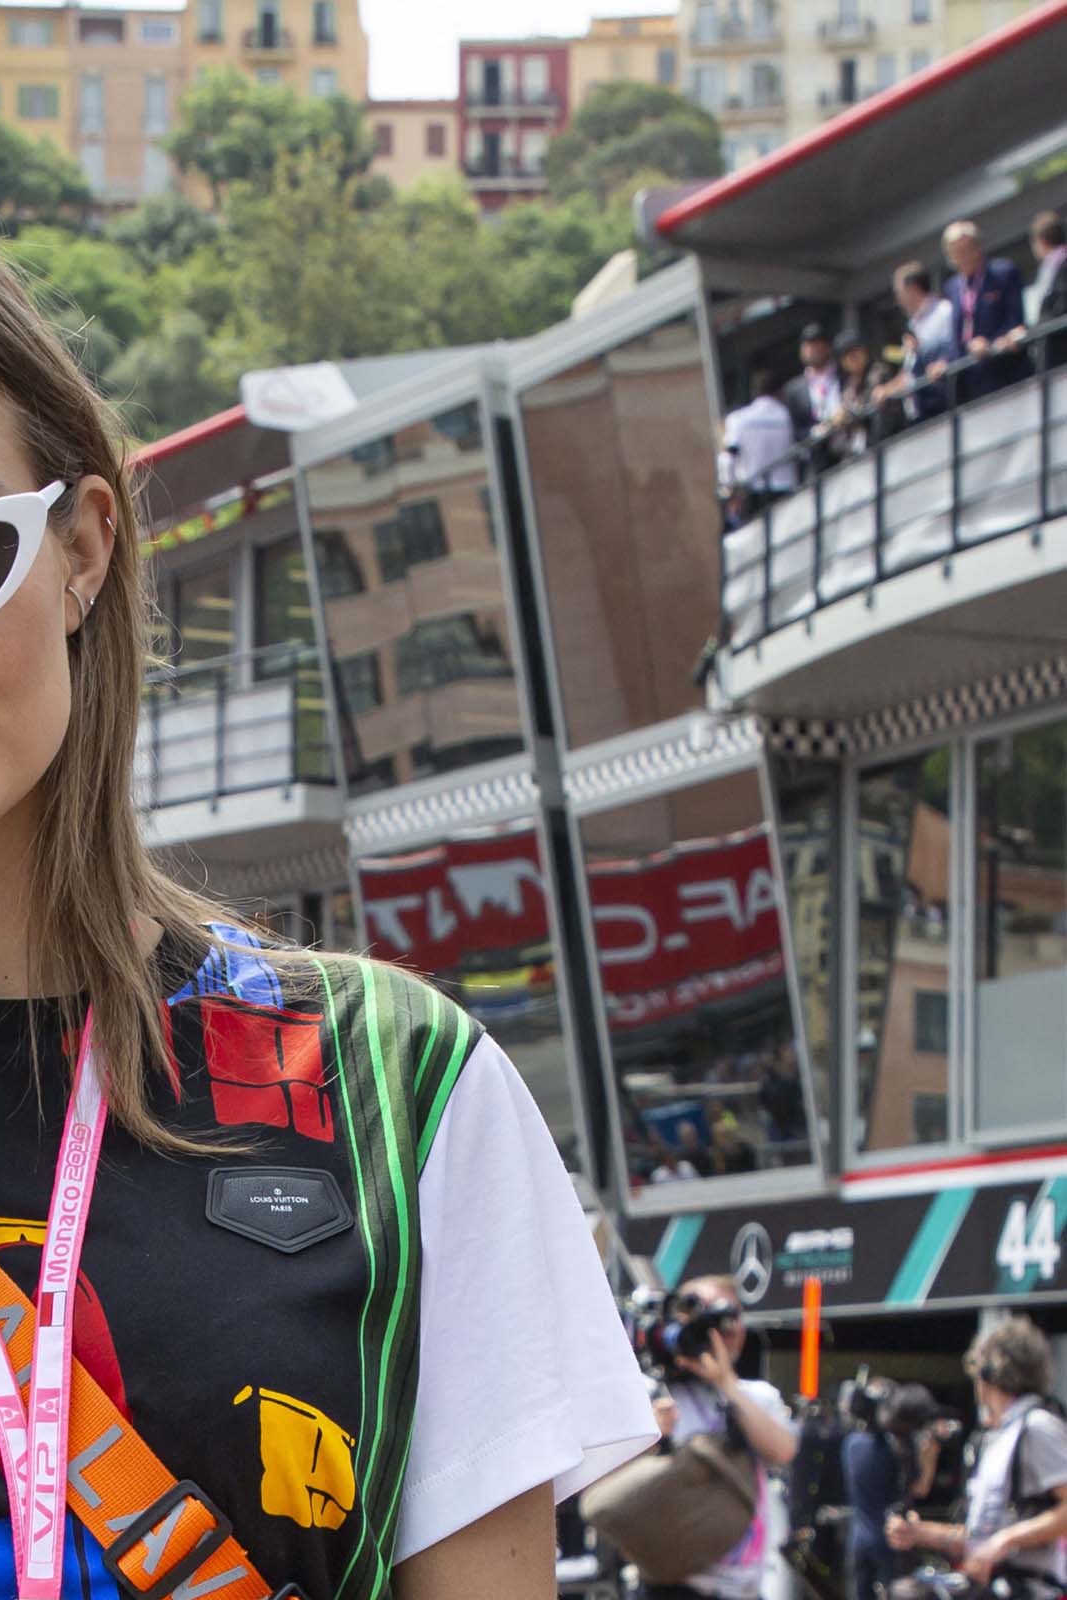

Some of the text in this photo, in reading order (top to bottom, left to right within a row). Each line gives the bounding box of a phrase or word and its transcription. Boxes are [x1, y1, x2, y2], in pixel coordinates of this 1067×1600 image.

[46, 1122, 92, 1283] Monaco 2019
[249, 1196, 309, 1204] LOUIS VUITTON
[996, 1200, 1061, 1281] 44
[33, 1441, 55, 1544] VIP
